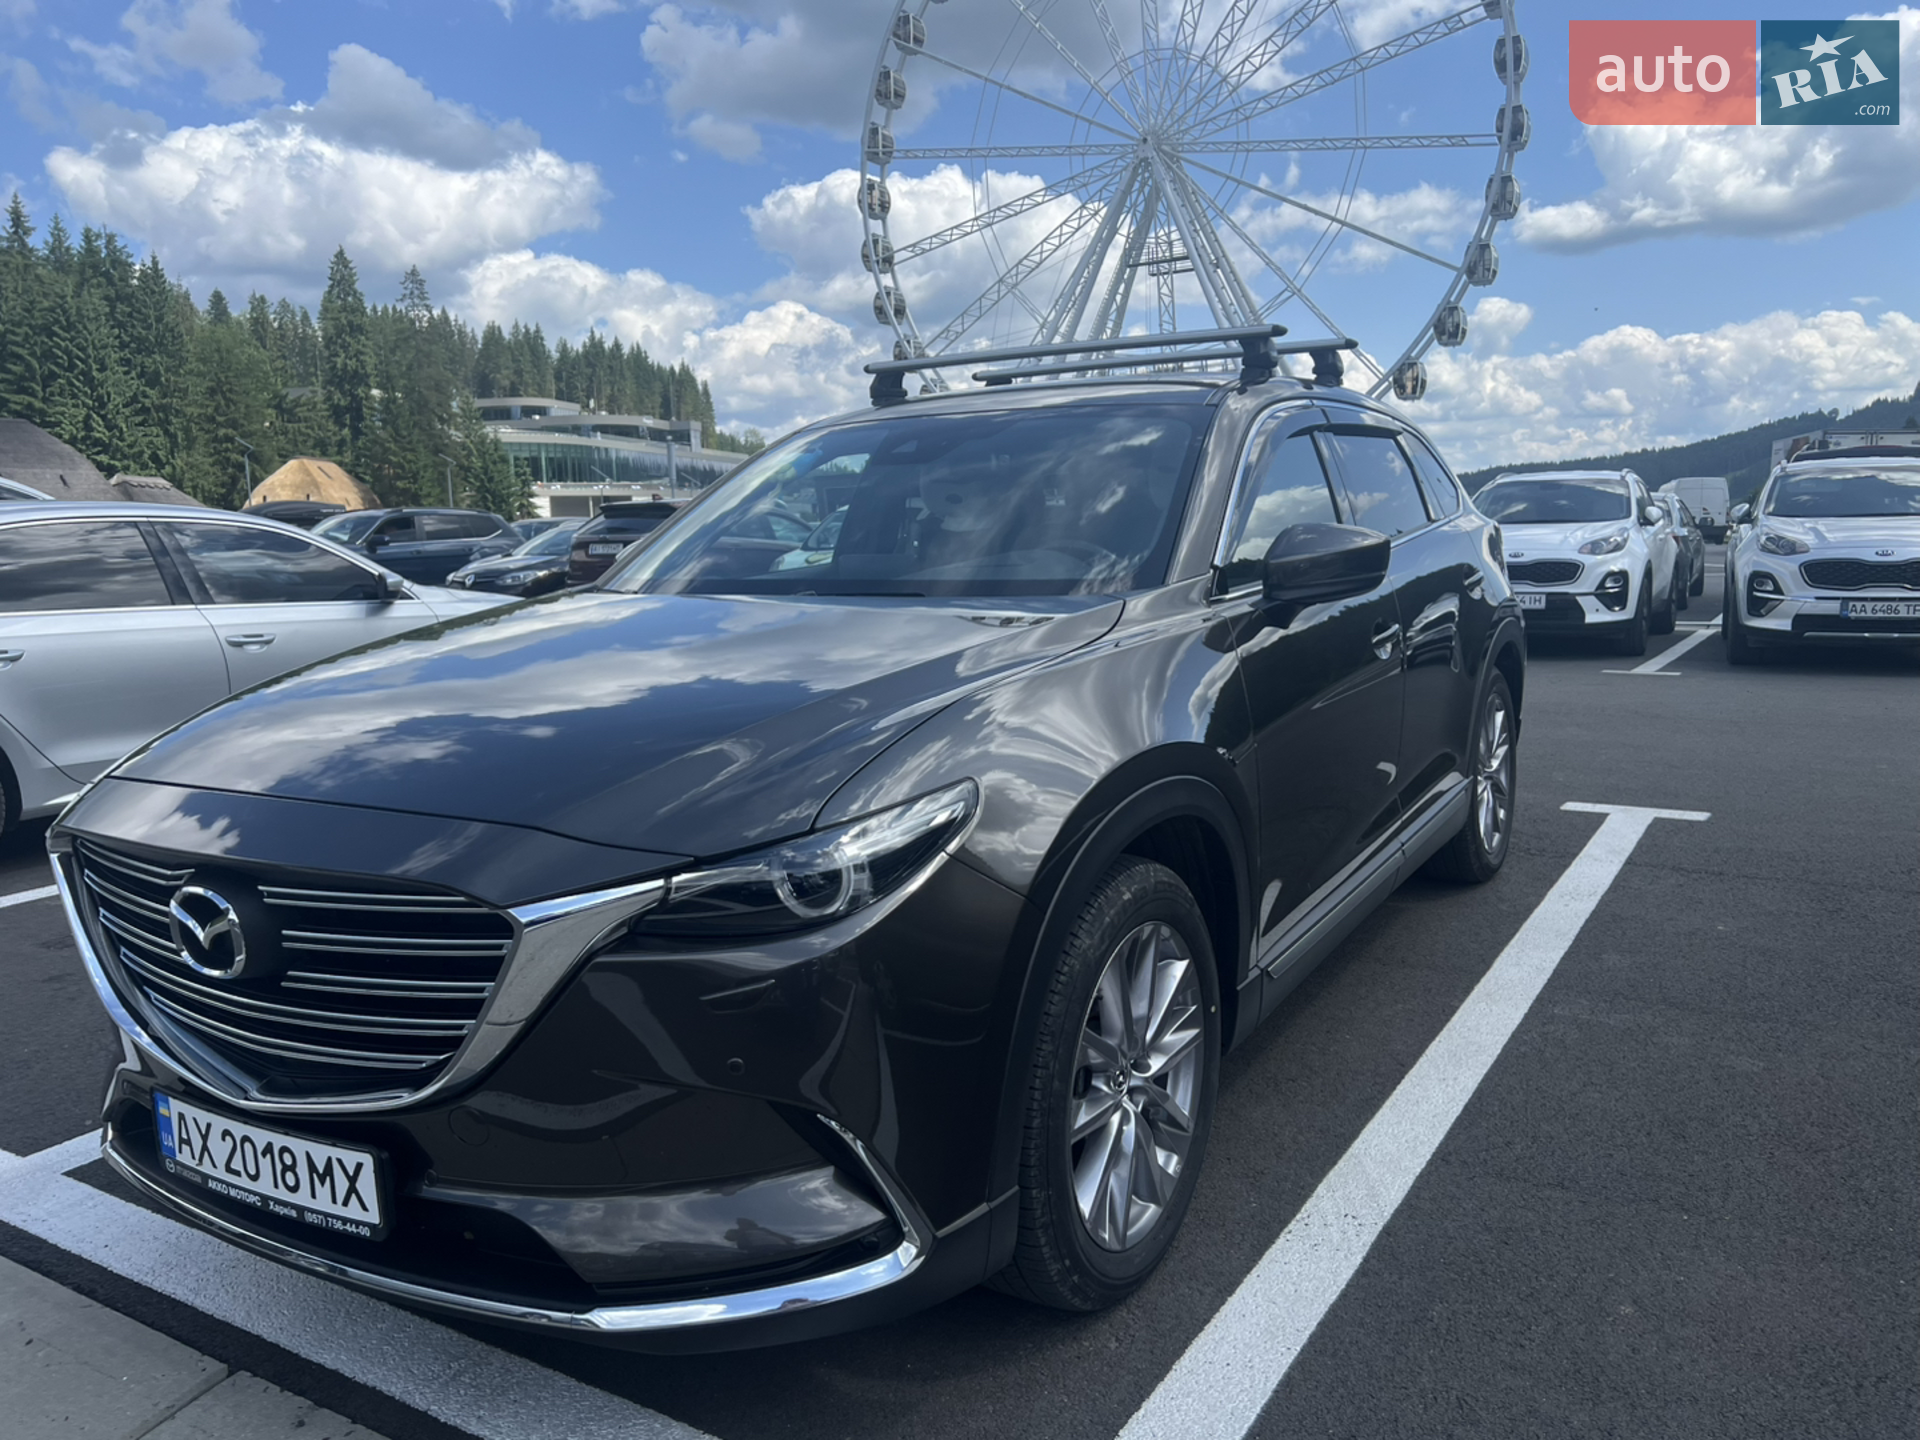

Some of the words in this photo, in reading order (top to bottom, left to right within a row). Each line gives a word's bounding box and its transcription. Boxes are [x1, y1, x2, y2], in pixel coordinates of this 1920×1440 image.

[1849, 603, 1868, 615] AA
[1871, 603, 1901, 616] 6486
[161, 1131, 174, 1149] UA
[177, 1111, 218, 1170] AX
[221, 1128, 301, 1194] 2018
[305, 1150, 370, 1213] MX
[304, 1210, 326, 1227] (057)
